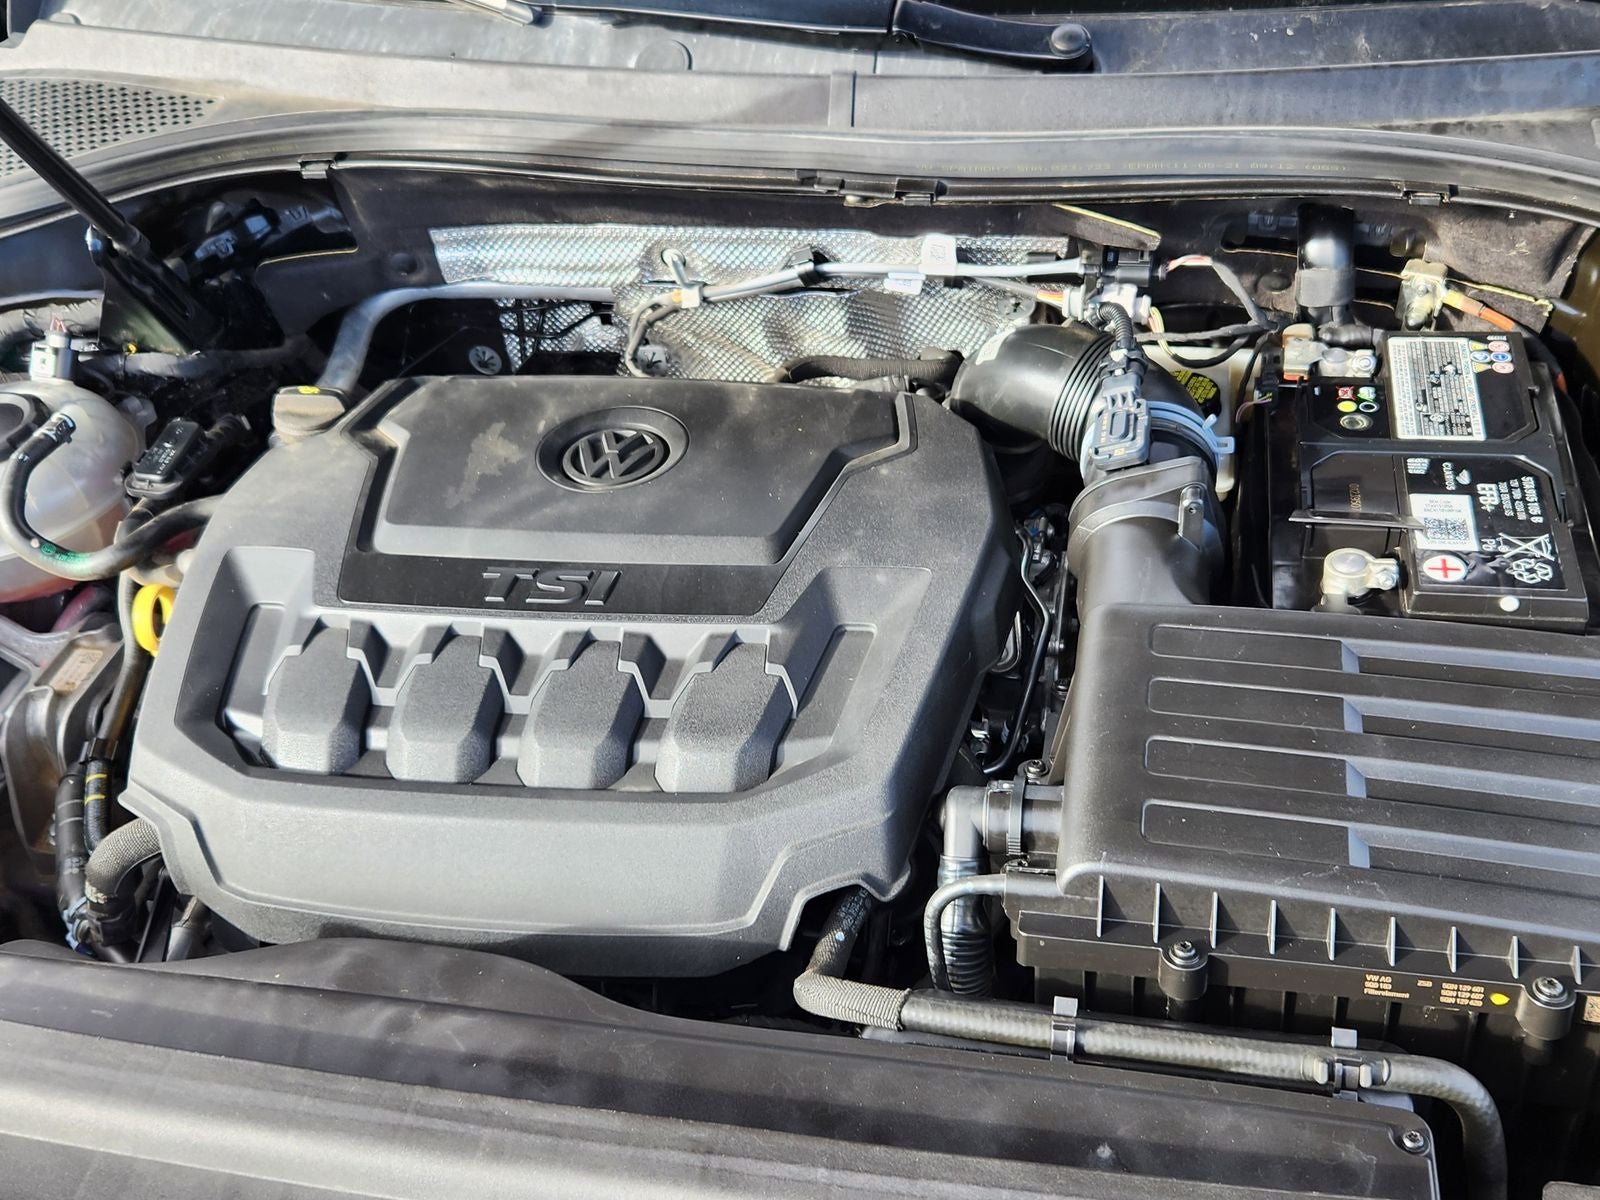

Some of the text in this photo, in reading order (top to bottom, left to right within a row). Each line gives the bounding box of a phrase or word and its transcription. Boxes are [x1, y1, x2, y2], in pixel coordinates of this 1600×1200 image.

[482, 566, 623, 606] TSI
[1365, 974, 1380, 982] VW
[1363, 988, 1410, 999] Filterelement
